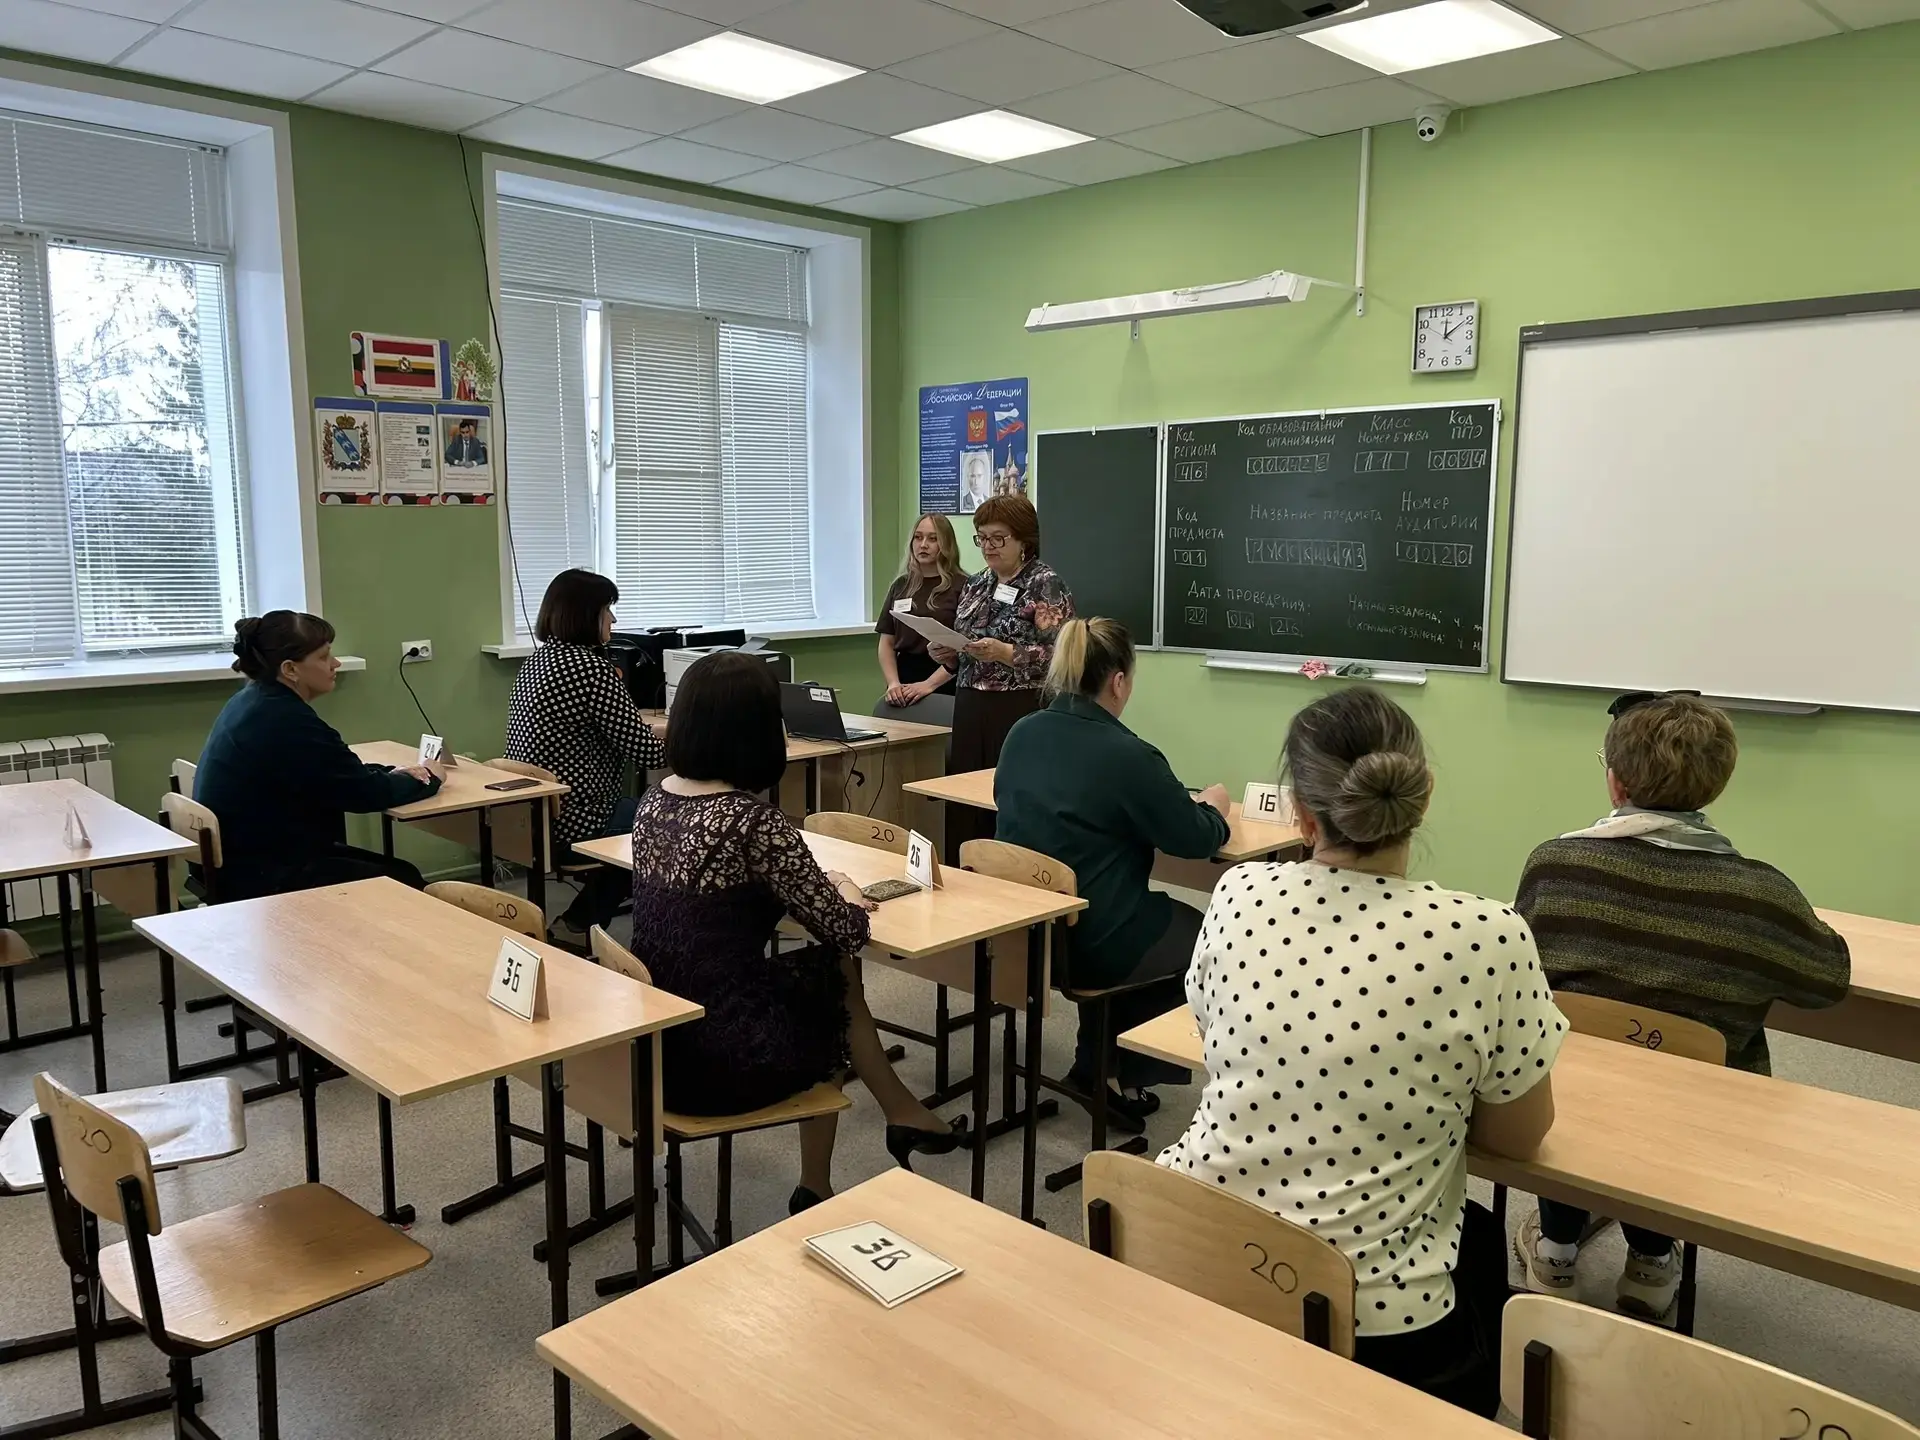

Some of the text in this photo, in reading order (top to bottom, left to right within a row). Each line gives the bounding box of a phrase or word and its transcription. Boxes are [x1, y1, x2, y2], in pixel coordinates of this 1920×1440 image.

[1429, 308, 1438, 318] 11
[1441, 306, 1454, 317] 12
[1458, 306, 1464, 316] 1
[1419, 319, 1430, 330] 10
[1465, 315, 1474, 325] 2
[1419, 334, 1426, 344] 9
[1465, 330, 1474, 340] 3
[1418, 349, 1426, 359] 8
[1464, 345, 1472, 355] 4
[1426, 358, 1434, 368] 7
[1441, 356, 1449, 366] 6
[1454, 356, 1462, 366] 5
[973, 383, 1022, 400] ФЕДЕРАЦИИ
[1449, 410, 1473, 426] Код
[1176, 427, 1195, 442] Код
[1237, 422, 1255, 436] Код
[1452, 424, 1483, 440] ППЭ
[1176, 506, 1198, 522] Код
[870, 826, 895, 843] 20
[1032, 862, 1052, 886] 20
[495, 902, 518, 920] 20
[78, 1115, 112, 1154] 20
[1244, 1242, 1299, 1295] 20
